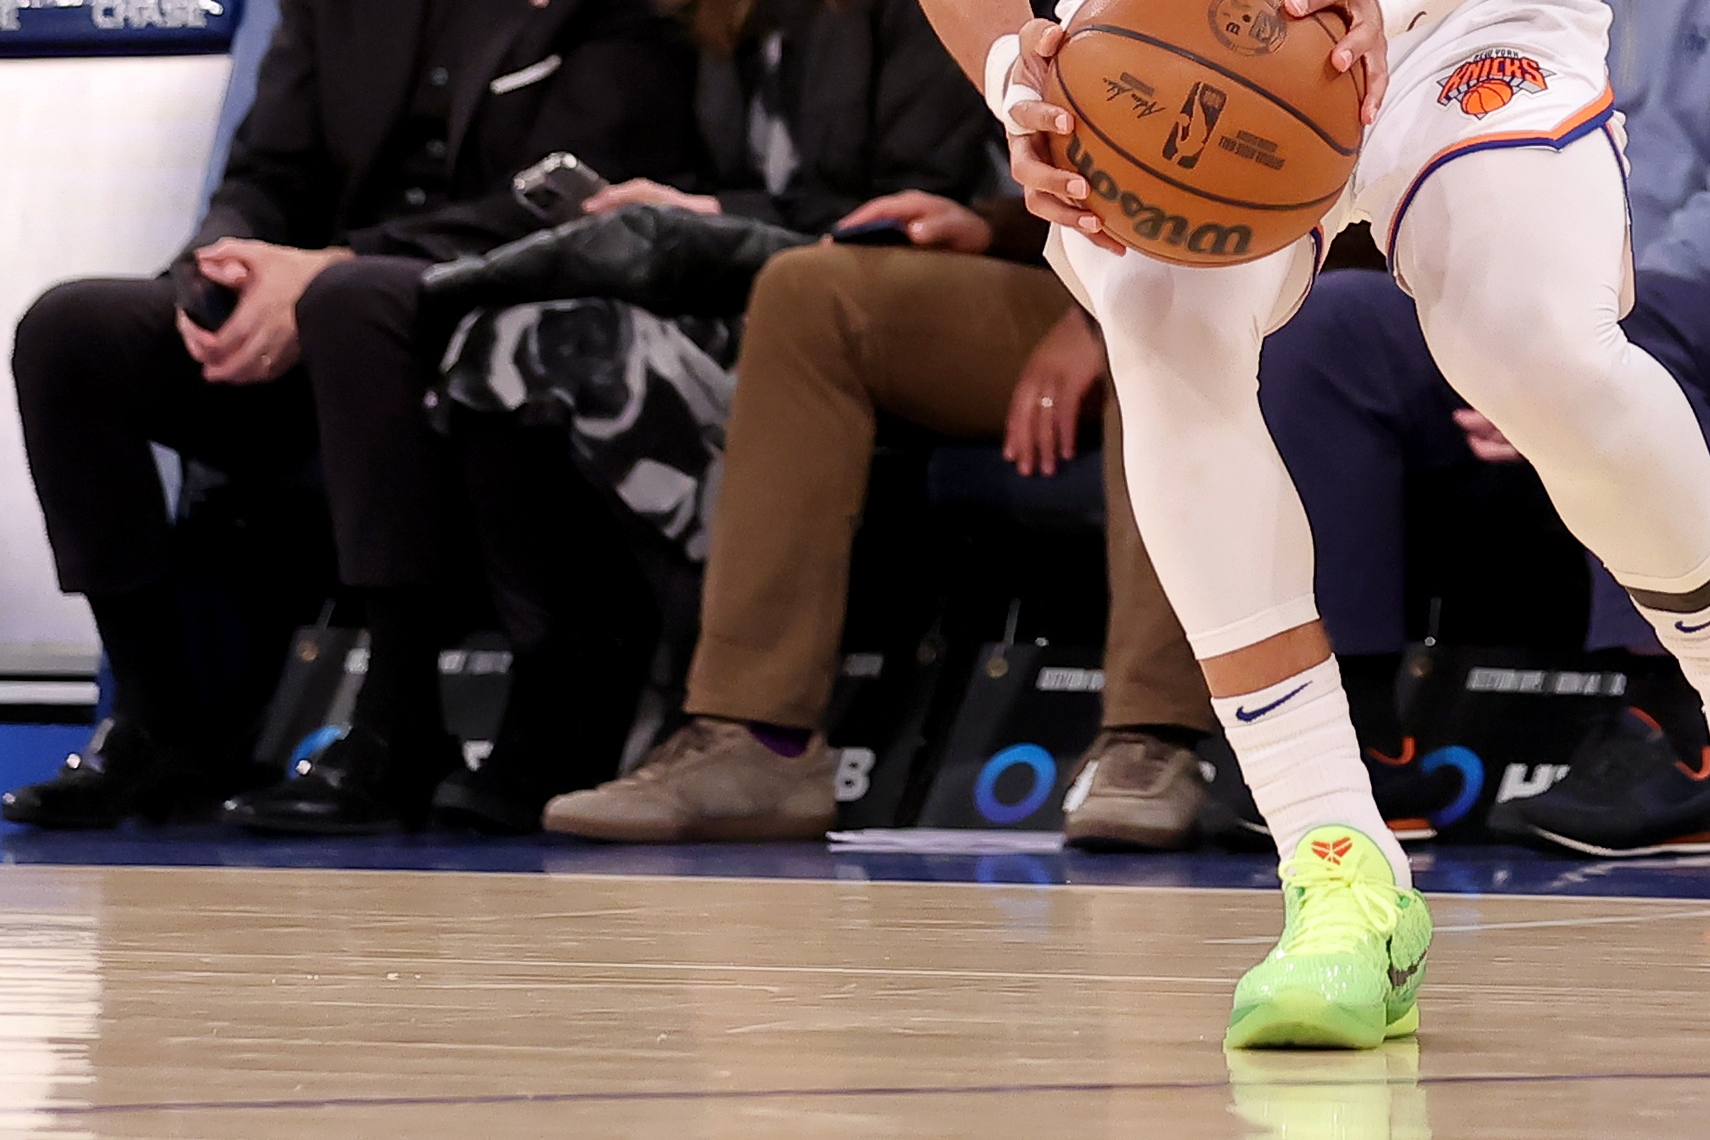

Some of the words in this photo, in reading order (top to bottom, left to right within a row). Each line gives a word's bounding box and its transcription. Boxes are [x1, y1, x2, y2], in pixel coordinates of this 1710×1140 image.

[1472, 49, 1494, 61] NEW
[1495, 49, 1519, 59] YORK
[1437, 56, 1548, 106] KNICKS
[1066, 131, 1253, 255] Wilson
